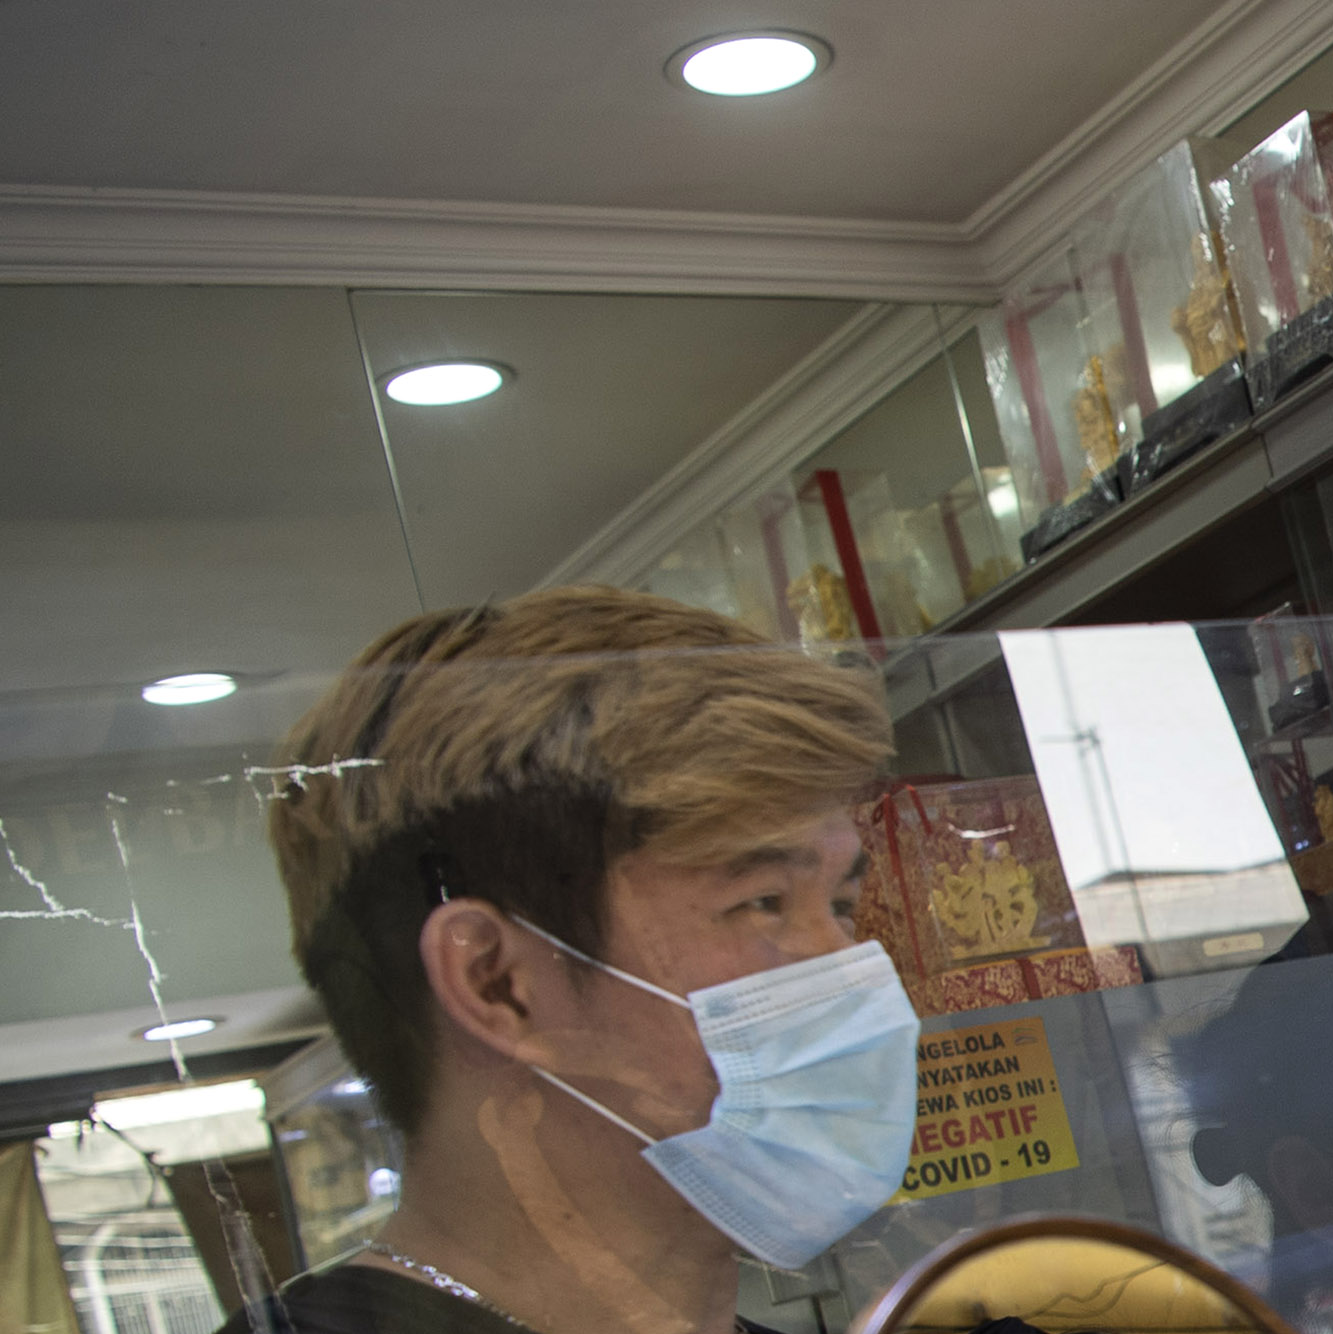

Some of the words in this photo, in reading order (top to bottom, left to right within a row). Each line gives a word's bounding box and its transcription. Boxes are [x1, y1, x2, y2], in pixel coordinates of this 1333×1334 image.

[964, 1084, 1012, 1108] KIOS
[1018, 1078, 1045, 1097] INI
[902, 1151, 991, 1190] COVID
